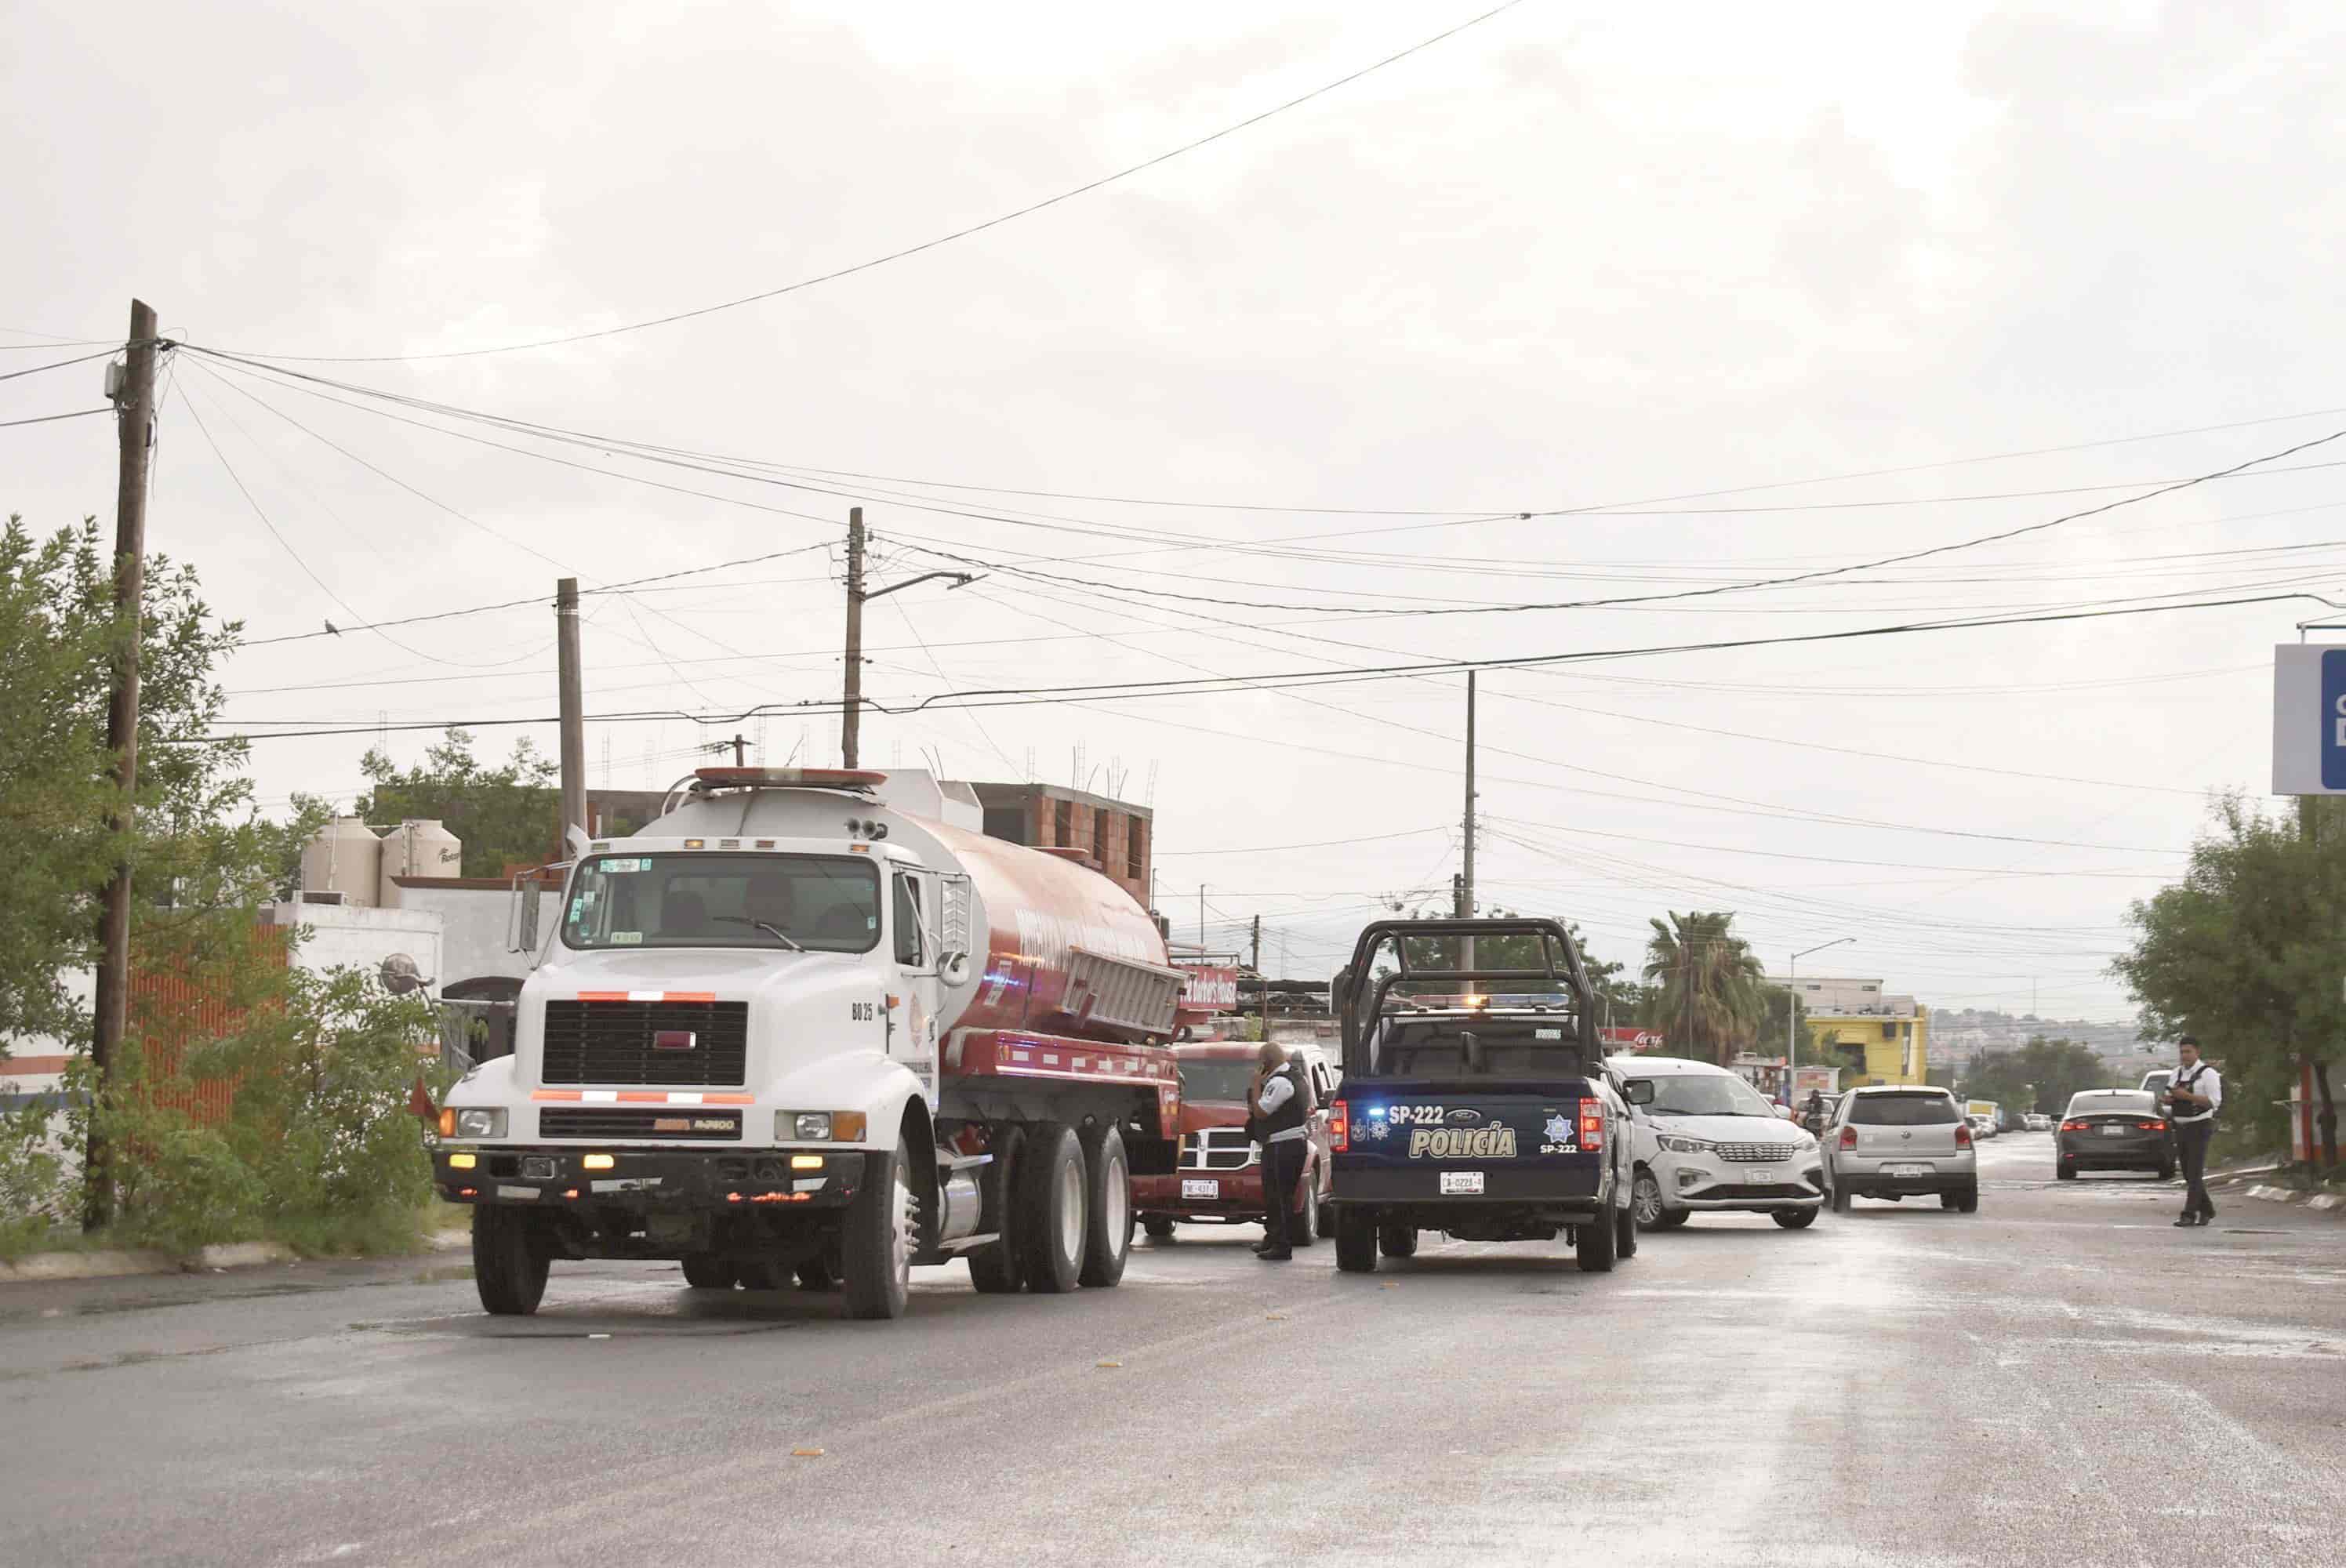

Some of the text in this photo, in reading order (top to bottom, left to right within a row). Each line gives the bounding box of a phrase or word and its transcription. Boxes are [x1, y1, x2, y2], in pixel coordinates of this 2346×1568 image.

[863, 1003, 873, 1021] 25
[1389, 1105, 1444, 1124] SP-222
[1409, 1121, 1517, 1159] POLICÍA
[1540, 1145, 1578, 1154] SP-222
